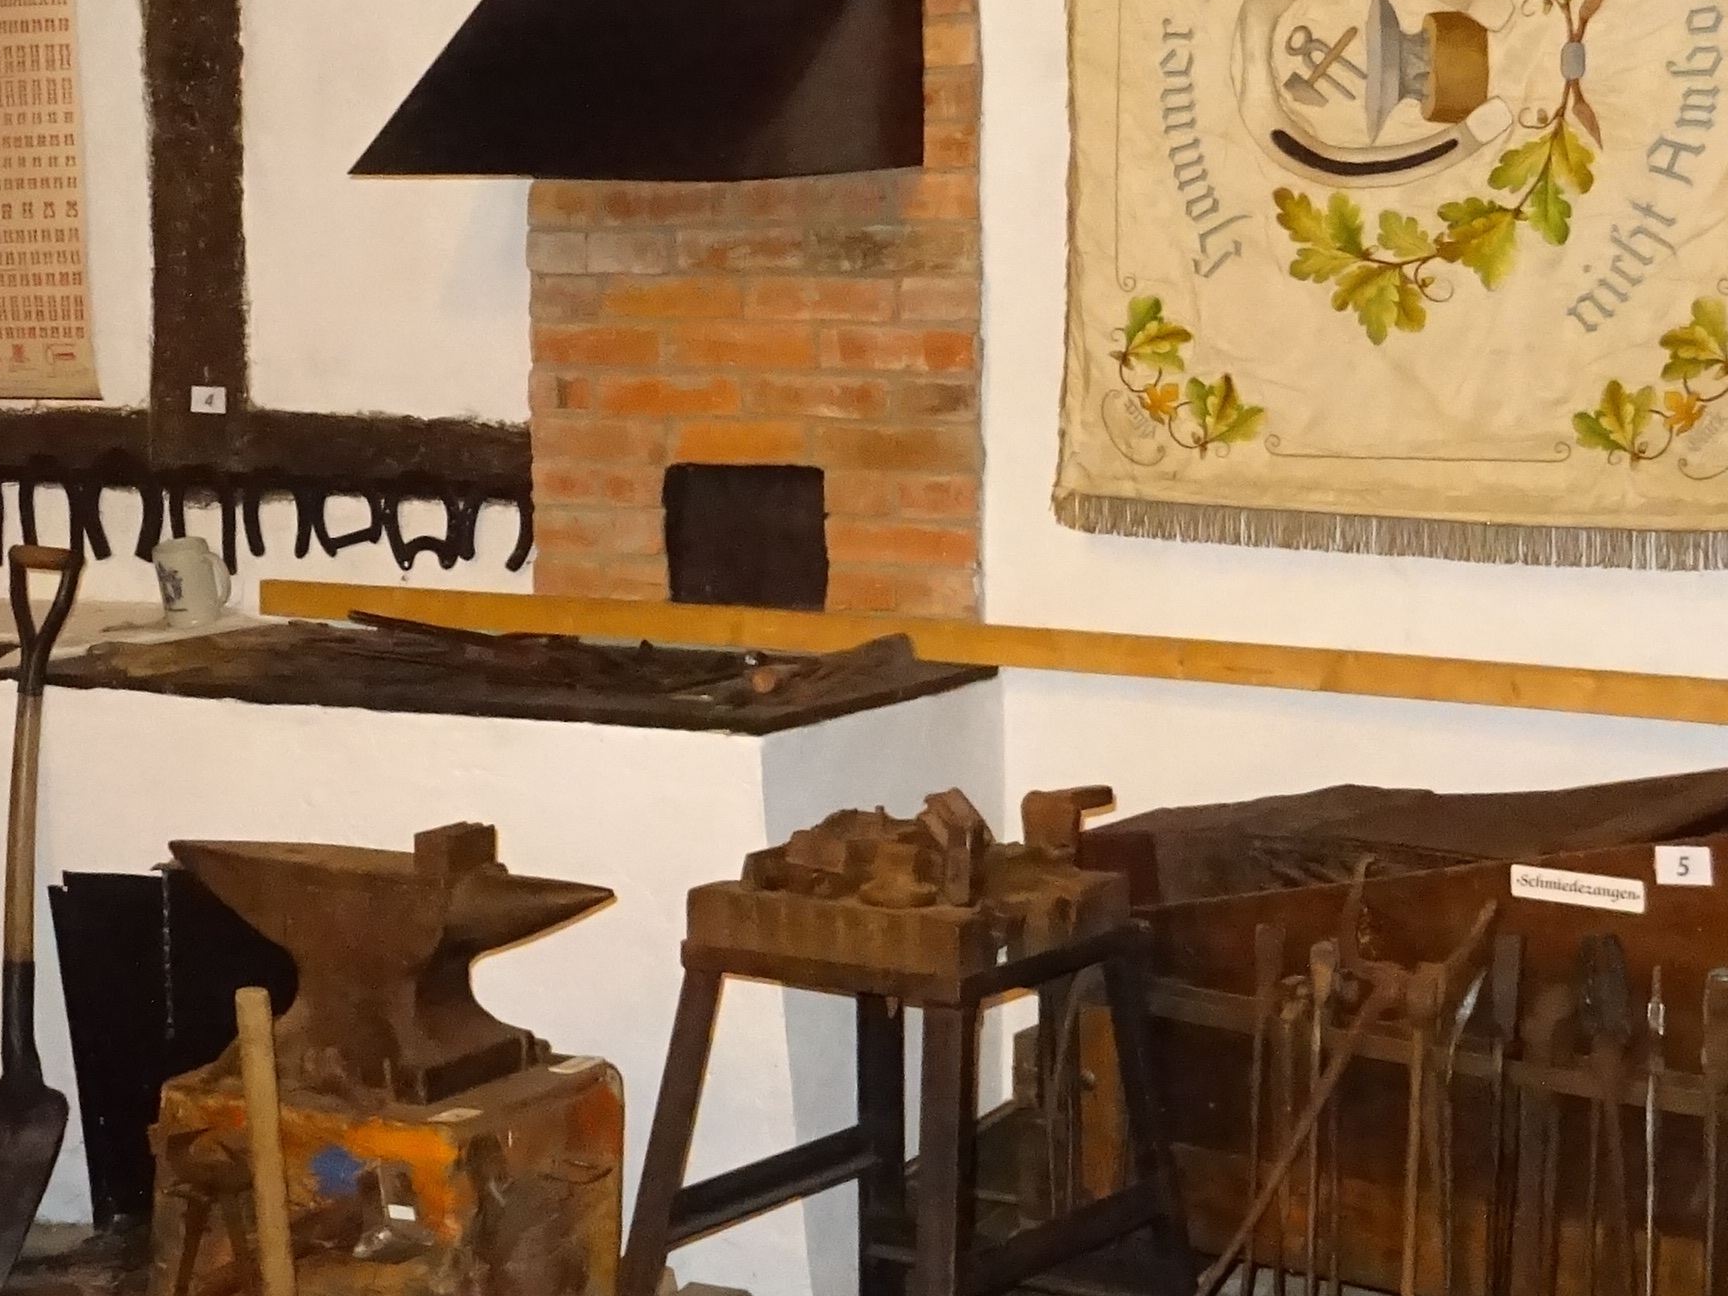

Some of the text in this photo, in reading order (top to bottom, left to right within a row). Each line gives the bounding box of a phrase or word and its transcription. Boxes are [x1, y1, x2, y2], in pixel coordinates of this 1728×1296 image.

[1160, 16, 1254, 279] Hammer
[1567, 198, 1678, 334] nicht
[204, 393, 215, 407] 4
[1676, 855, 1691, 877] 5
